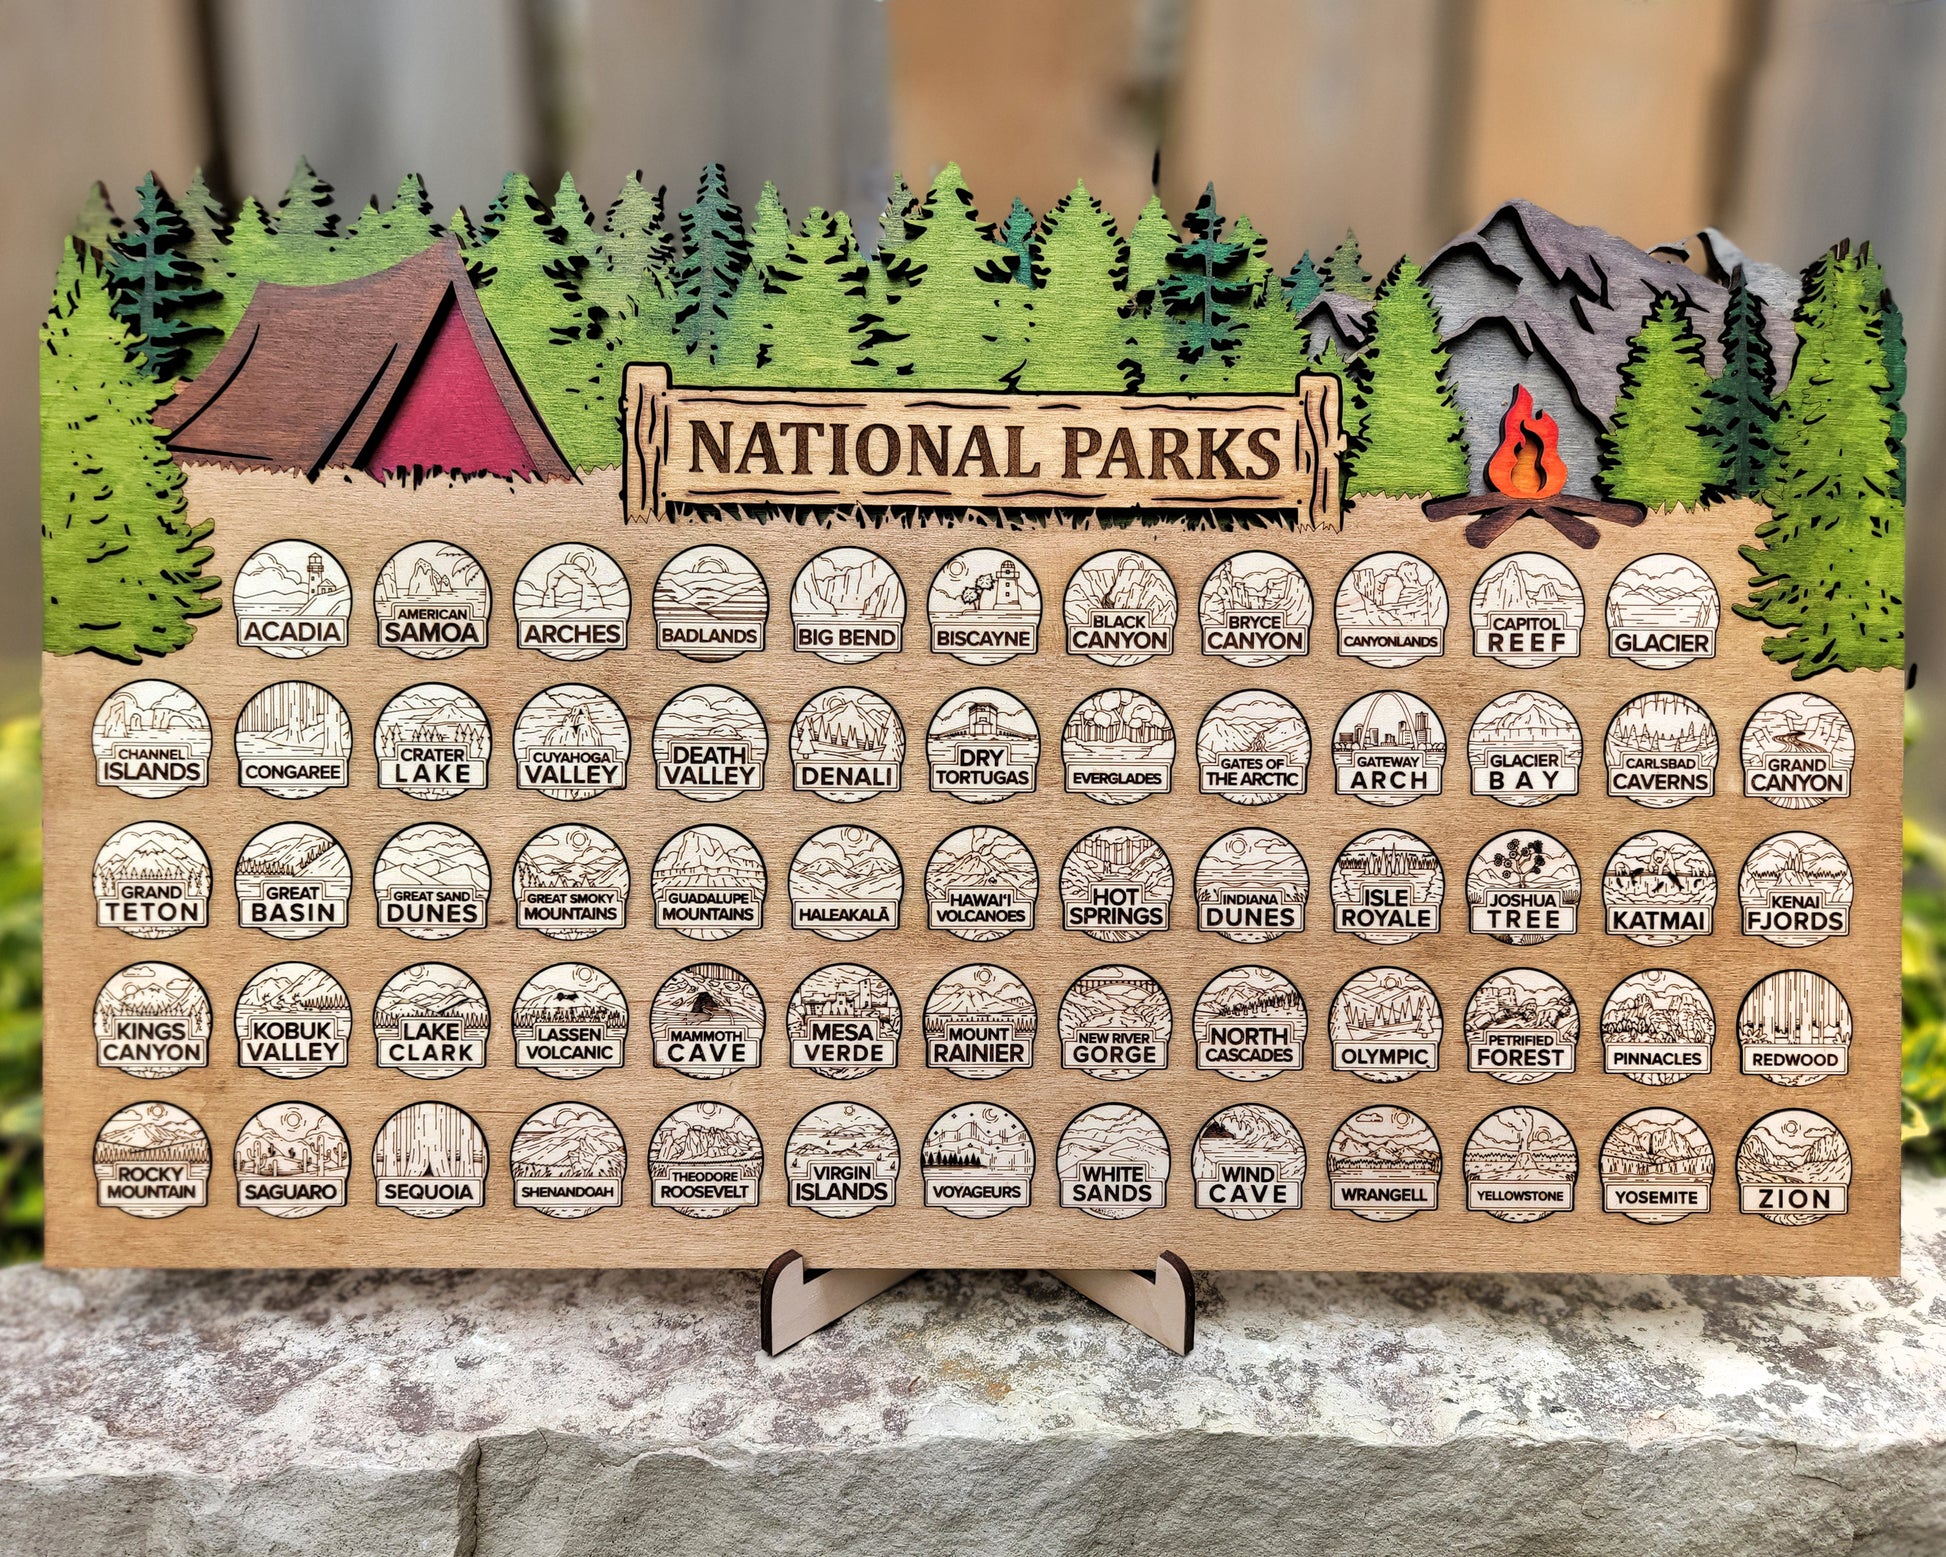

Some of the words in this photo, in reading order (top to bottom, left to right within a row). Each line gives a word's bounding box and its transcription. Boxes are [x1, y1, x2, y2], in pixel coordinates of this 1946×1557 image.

[688, 420, 1041, 478] NATIONAL
[1061, 427, 1280, 480] PARKS
[398, 609, 467, 620] AMERICAN
[1093, 615, 1145, 629] BLACK
[1229, 616, 1281, 629] BRYCE
[244, 621, 341, 641] ACADIA
[1493, 617, 1561, 631] CAPITOL
[385, 622, 479, 643] SAMOA
[524, 624, 621, 643] ARCHES
[662, 628, 757, 643] BADLANDS
[799, 629, 833, 646] BIG
[839, 629, 896, 646] BEND
[937, 631, 1030, 646] BISCAYNE
[1073, 631, 1167, 649] CANYON
[1207, 632, 1302, 649] CANYON
[1344, 636, 1438, 647] CANYONLANDS
[1488, 633, 1565, 652] REEF
[1615, 633, 1709, 652] GLACIER
[118, 749, 185, 760] CHANNEL
[401, 748, 464, 762] CRATER
[533, 752, 611, 763] CUYAHOGA
[674, 746, 746, 764] DEATH
[960, 749, 1004, 767] DRY
[1357, 756, 1420, 768] GATEWAY
[1490, 754, 1559, 768] GLACIER
[104, 762, 200, 781] ISLANDS
[1221, 758, 1263, 770] GATES
[1266, 759, 1284, 769] OF
[1626, 758, 1696, 769] CARLSBAD
[1768, 759, 1826, 772] GRAND
[246, 765, 340, 779] CONGAREE
[396, 764, 470, 783] LAKE
[525, 765, 618, 784] VALLEY
[664, 766, 755, 785] VALLEY
[802, 767, 891, 786] DENALI
[936, 770, 1029, 785] TORTUGAS
[1073, 772, 1162, 785] EVERGLADES
[1206, 772, 1237, 786] THE
[1240, 772, 1299, 786] ARCTIC
[1350, 771, 1427, 789] ARCH
[1490, 771, 1559, 790] BAY
[1613, 773, 1708, 790] CAVERNS
[1751, 774, 1842, 792] CANYON
[121, 886, 182, 899] GRAND
[266, 887, 320, 900] GREAT
[393, 891, 434, 901] GREAT
[436, 891, 470, 902] SAND
[527, 893, 567, 904] GREAT
[570, 893, 614, 904] SMOKY
[668, 893, 749, 904] GUADALUPE
[1093, 888, 1139, 906] HOT
[1223, 894, 1278, 905] INDIANA
[1365, 889, 1408, 907] ISLE
[1490, 894, 1557, 907] JOSHUA
[1772, 896, 1819, 909] KENAI
[105, 902, 197, 921] TETON
[252, 903, 334, 922] BASIN
[387, 904, 477, 923] DUNES
[524, 907, 617, 920] MOUNTAINS
[663, 908, 754, 921] MOUNTAINS
[936, 909, 1026, 922] VOLCANOES
[1070, 907, 1163, 925] SPRINGS
[1207, 908, 1295, 927] DUNES
[1342, 909, 1430, 927] ROYALE
[1487, 910, 1559, 929] TREE
[1614, 911, 1704, 930] KATMAI
[1745, 912, 1843, 933] FJORDS
[117, 1023, 186, 1041] KINGS
[254, 1022, 331, 1040] KOBUK
[404, 1023, 459, 1041] LAKE
[538, 1028, 601, 1042] LASSEN
[671, 1031, 742, 1042] MAMMOTH
[812, 1023, 874, 1041] MESA
[949, 1028, 1010, 1041] MOUNT
[1079, 1033, 1109, 1044] NEW
[1112, 1033, 1150, 1044] RIVER
[1211, 1027, 1288, 1045] NORTH
[1489, 1035, 1554, 1046] PETRIFIED
[103, 1044, 200, 1061] CANYON
[247, 1042, 339, 1061] VALLEY
[389, 1044, 473, 1061] CLARK
[526, 1046, 613, 1059] VOLCANIC
[668, 1043, 745, 1062] CAVE
[804, 1044, 883, 1061] VERDE
[934, 1044, 1024, 1062] RAINIER
[1073, 1045, 1156, 1063] GORGE
[1206, 1048, 1293, 1062] CASCADES
[1342, 1049, 1428, 1065] OLYMPIC
[1478, 1049, 1564, 1066] FOREST
[1614, 1052, 1702, 1065] PINNACLES
[1753, 1053, 1838, 1066] REDWOOD
[119, 1167, 184, 1182] ROCKY
[672, 1172, 738, 1182] THEODORE
[813, 1166, 871, 1180] VIRGIN
[1082, 1166, 1143, 1182] WHITE
[1221, 1166, 1275, 1183] WIND
[108, 1185, 196, 1199] MOUNTAIN
[245, 1184, 337, 1200] SAGUARO
[385, 1184, 473, 1200] SEQUOIA
[522, 1186, 614, 1198] SHENANDOAH
[661, 1185, 749, 1198] ROOSEVELT
[796, 1182, 888, 1201] ISLANDS
[933, 1186, 1021, 1198] VOYAGEURS
[1073, 1184, 1152, 1202] SANDS
[1209, 1184, 1286, 1203] CAVE
[1341, 1188, 1428, 1202] WRANGELL
[1477, 1191, 1563, 1201] YELLOWSTONE
[1615, 1191, 1697, 1204] YOSEMITE
[1759, 1189, 1829, 1209] ZION
